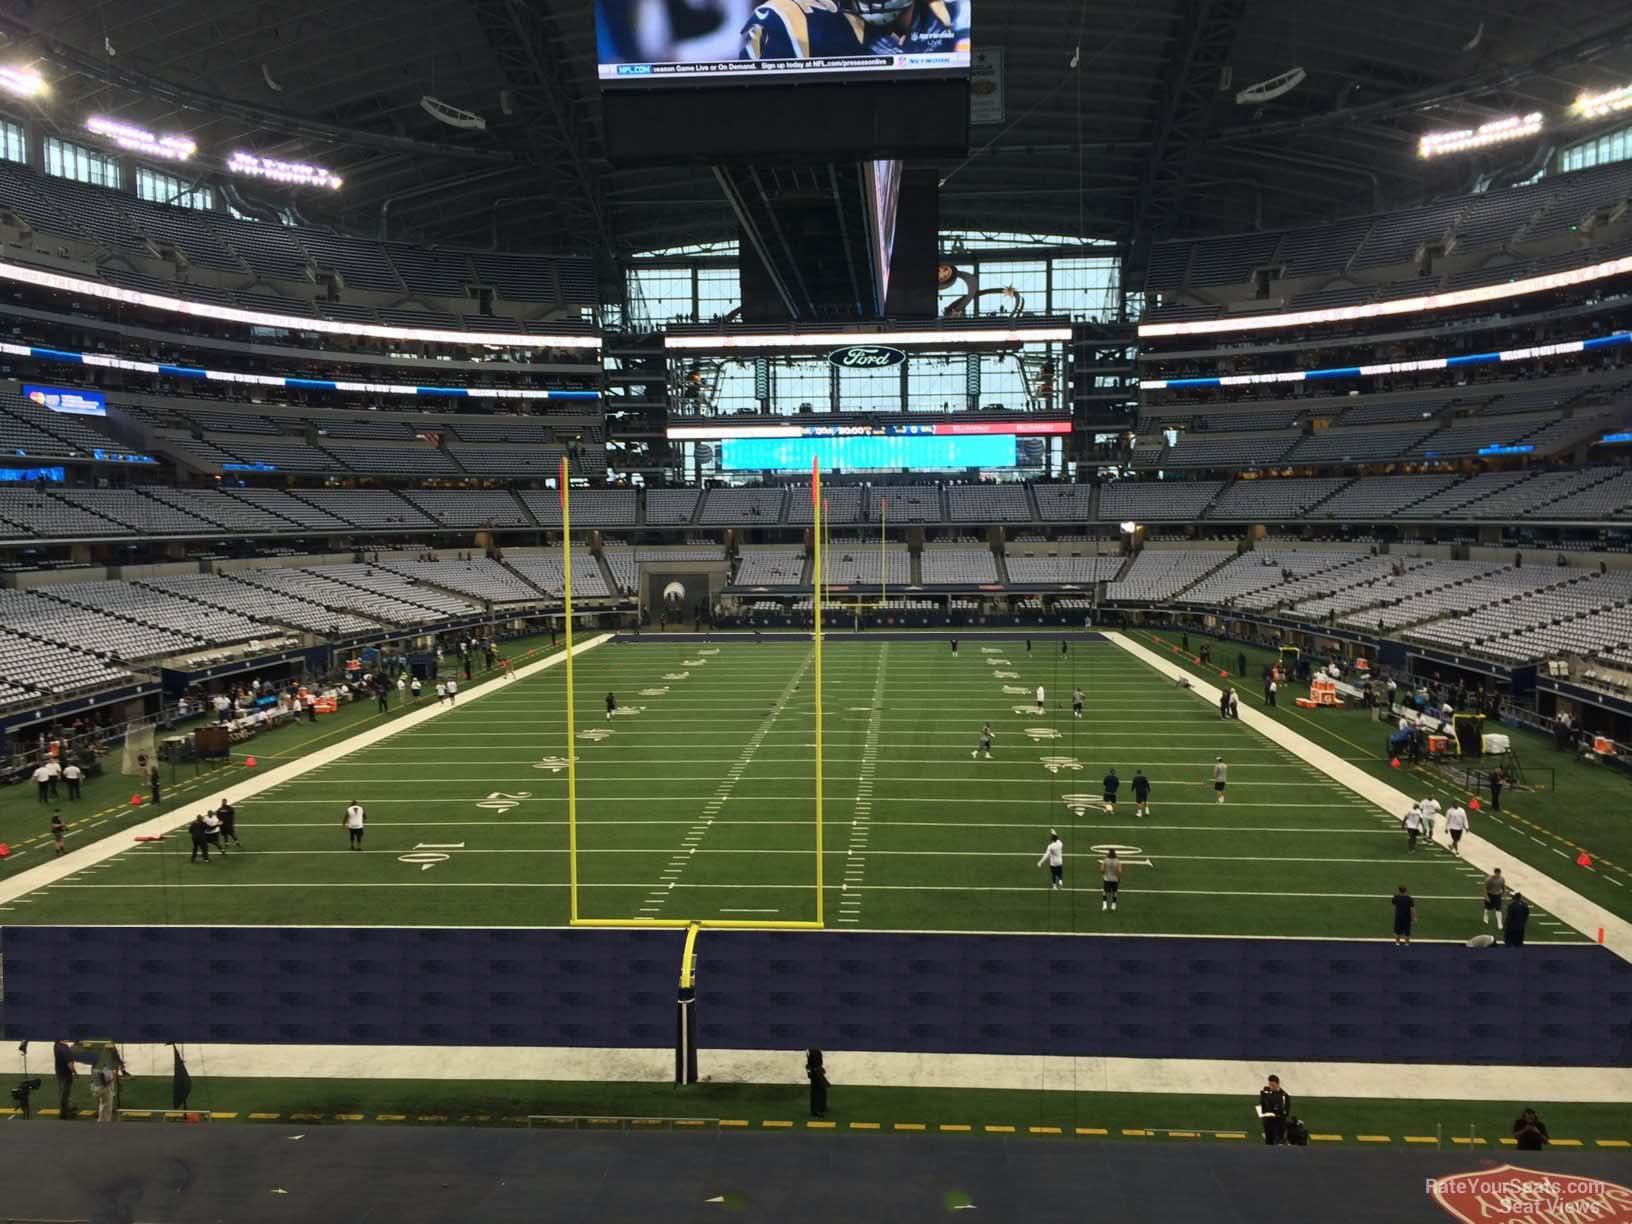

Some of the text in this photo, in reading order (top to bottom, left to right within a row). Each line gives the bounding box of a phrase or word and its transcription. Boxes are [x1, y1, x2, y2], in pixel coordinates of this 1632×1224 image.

[695, 64, 709, 72] Live
[761, 62, 776, 70] Sign
[776, 62, 785, 70] up
[786, 60, 804, 69] today
[805, 60, 812, 68] at
[843, 348, 891, 366] Ford
